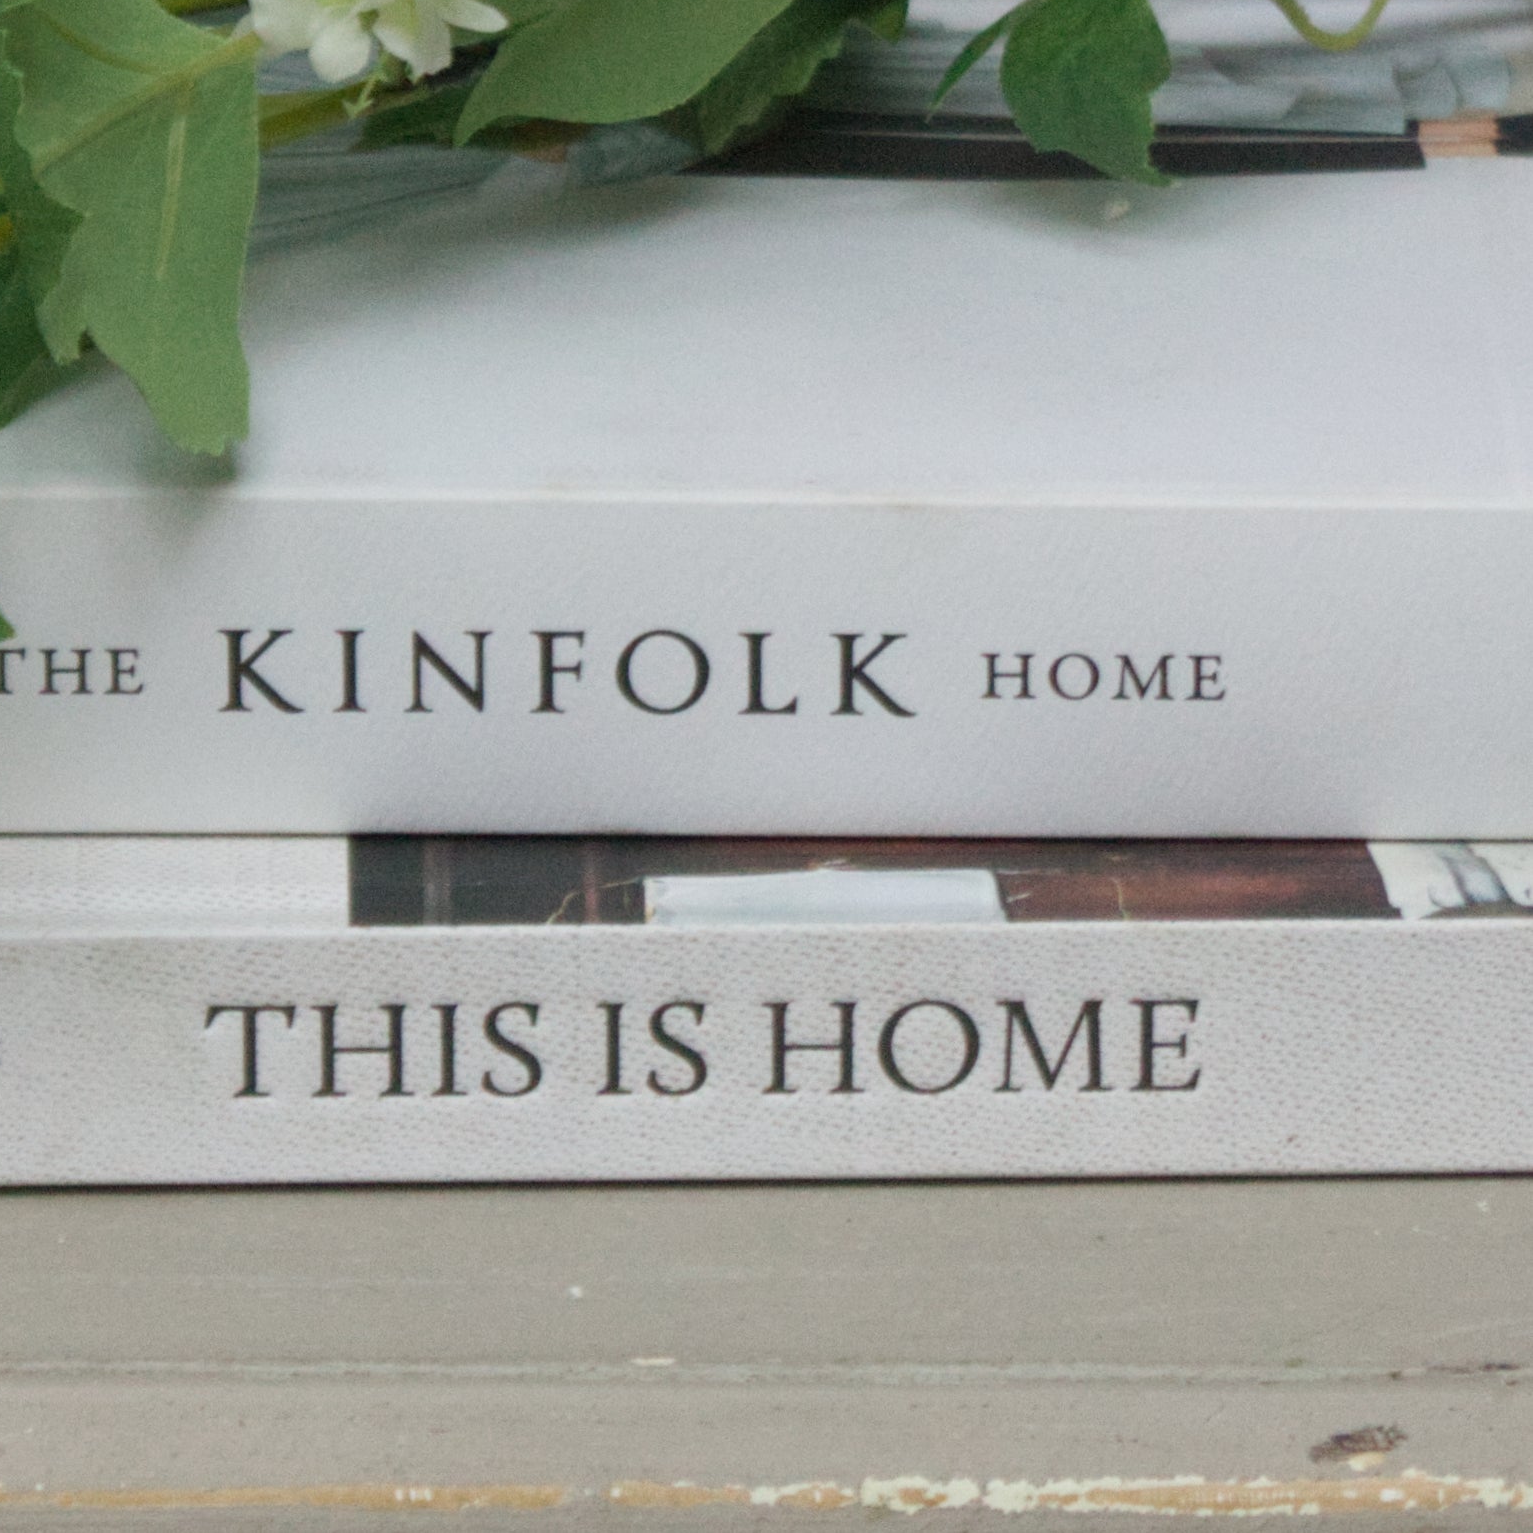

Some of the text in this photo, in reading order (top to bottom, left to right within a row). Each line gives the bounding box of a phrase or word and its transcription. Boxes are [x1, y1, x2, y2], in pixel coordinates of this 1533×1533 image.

[217, 628, 916, 718] KINFOLK
[982, 653, 1226, 701] HOME
[204, 995, 1202, 1101] THIS IS HOME
